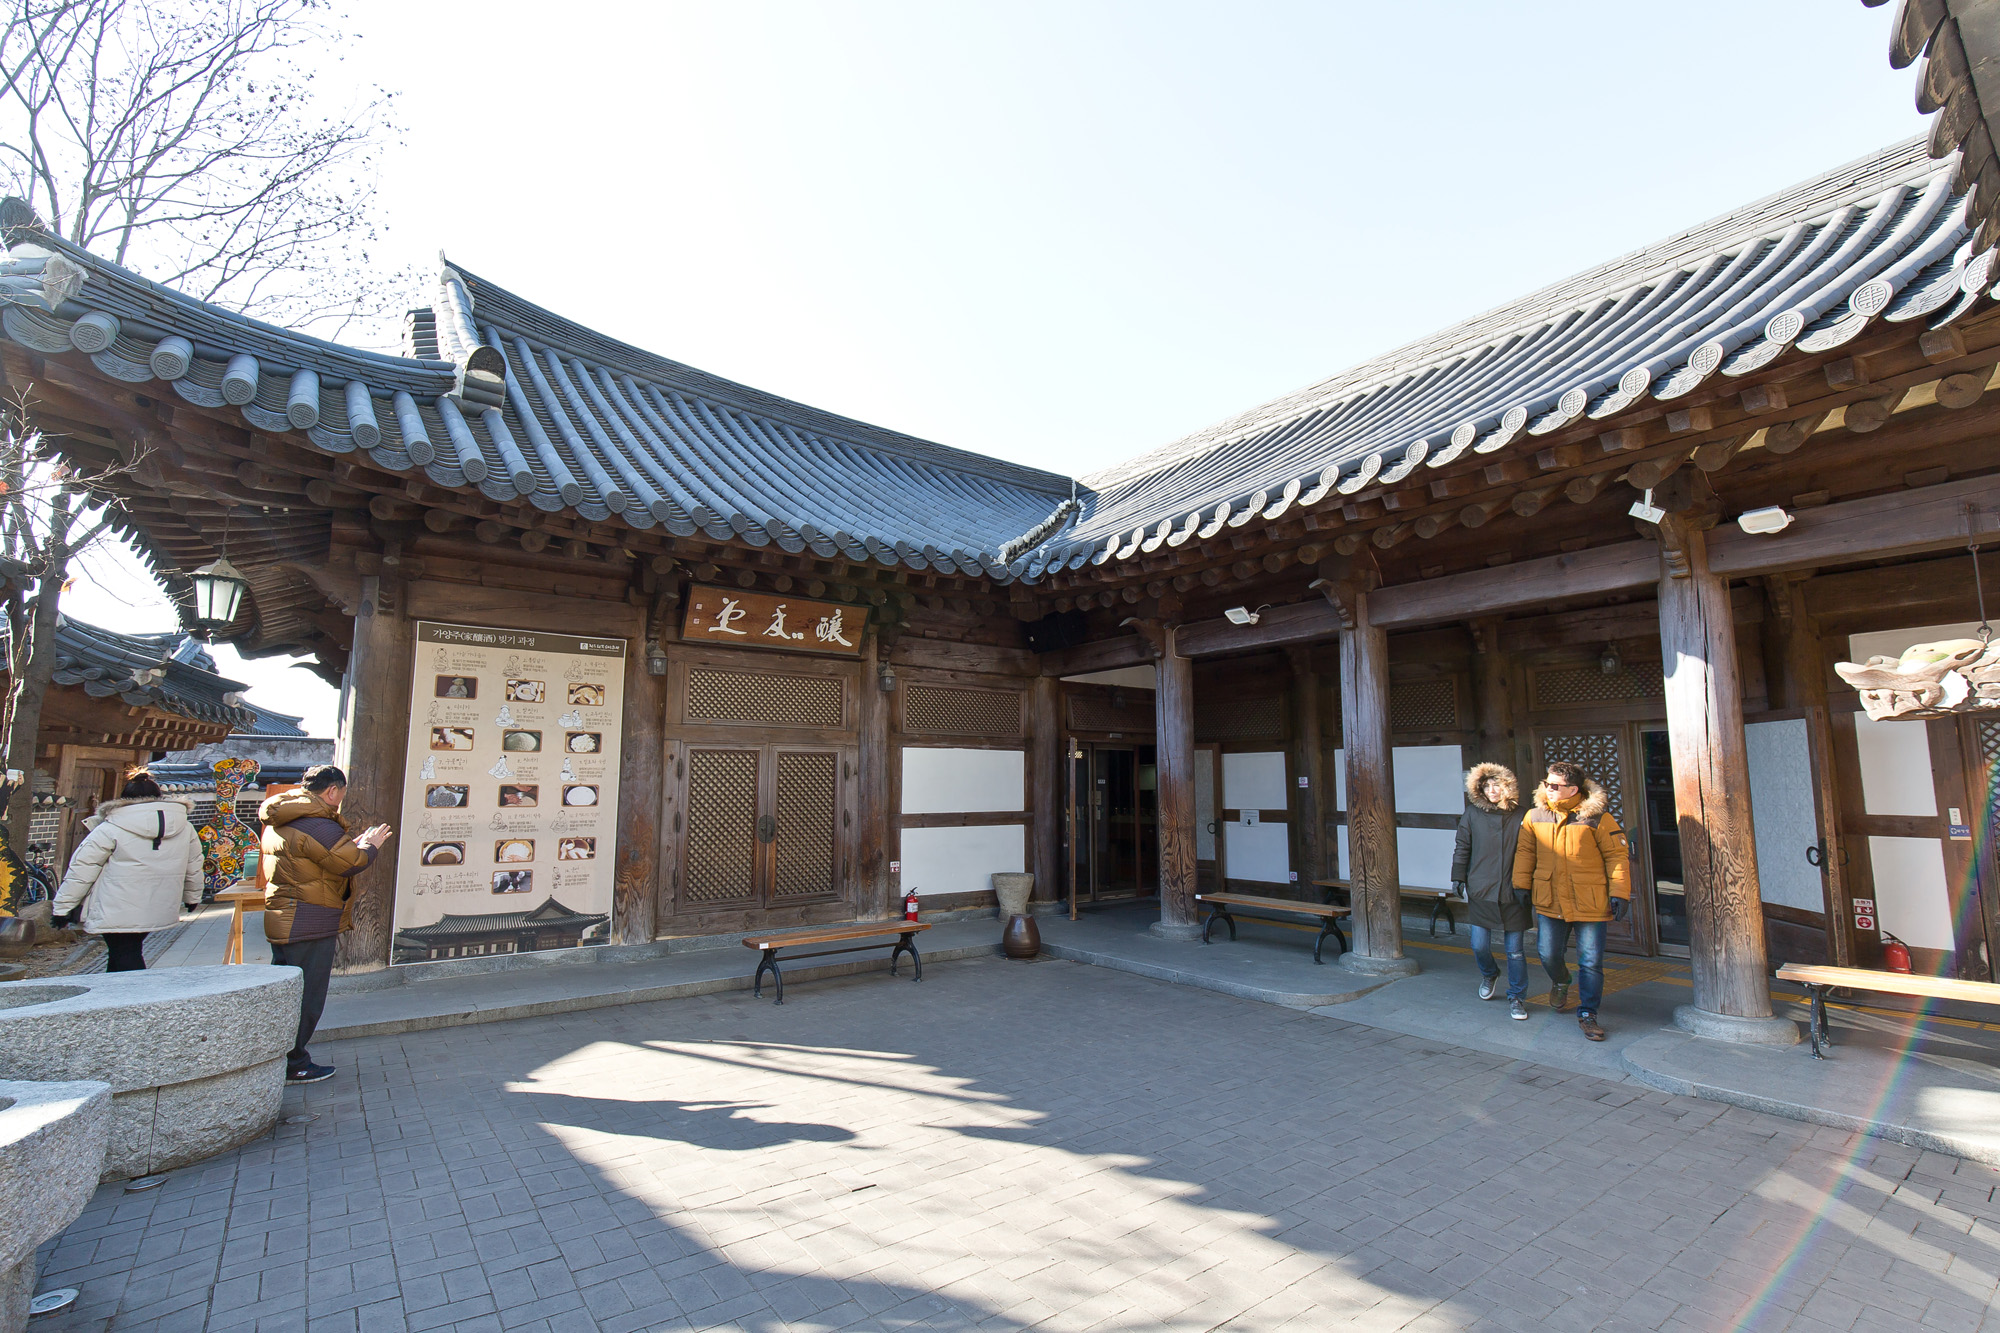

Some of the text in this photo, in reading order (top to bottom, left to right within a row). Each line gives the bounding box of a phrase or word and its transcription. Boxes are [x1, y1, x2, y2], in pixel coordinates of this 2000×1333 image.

[432, 628, 535, 646] 가양주(家釀酒) 빚기 과정
